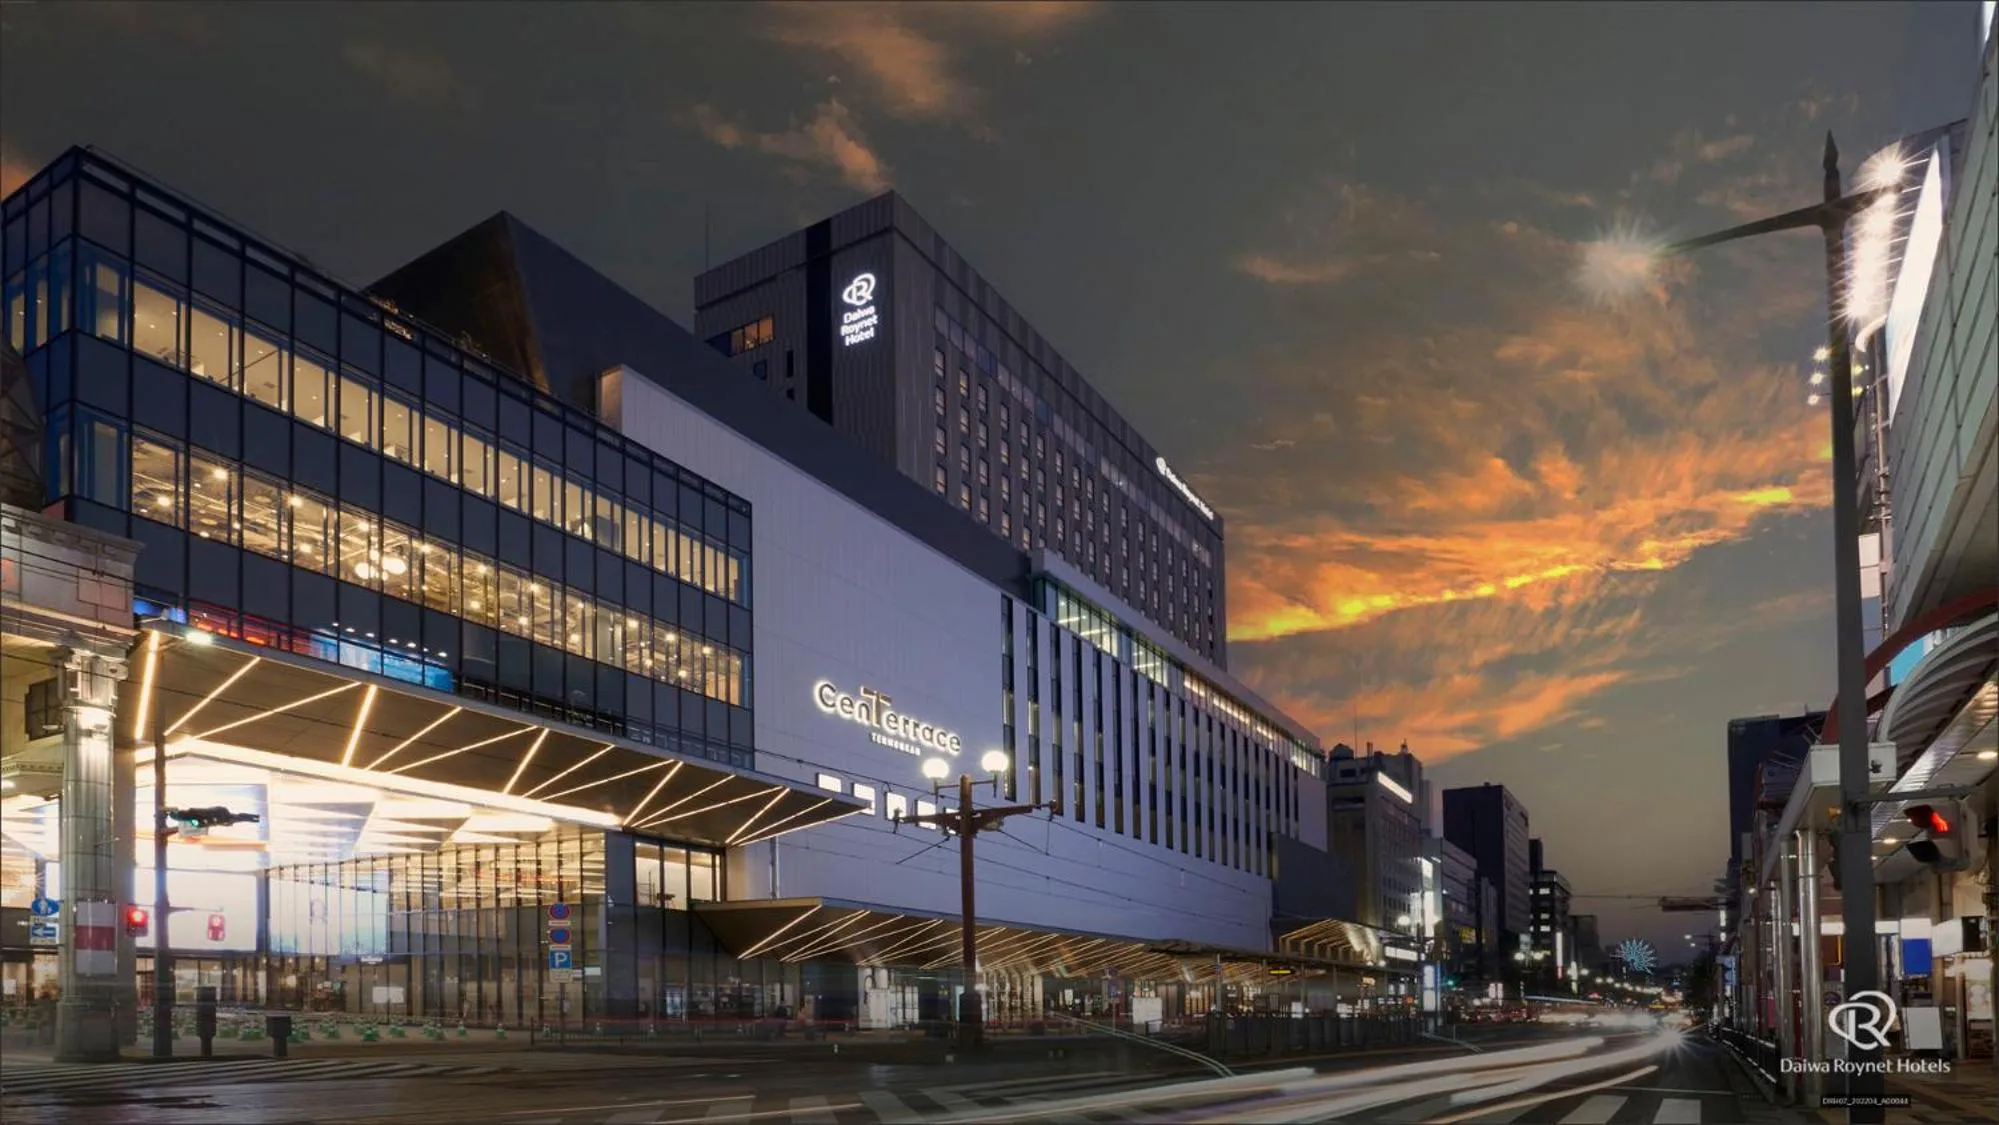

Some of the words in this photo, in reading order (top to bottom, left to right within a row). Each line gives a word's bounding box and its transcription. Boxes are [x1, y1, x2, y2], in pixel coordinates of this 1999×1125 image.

[843, 305, 875, 324] Daiwa
[841, 314, 878, 336] Roynet
[845, 327, 875, 346] Hotel
[815, 683, 961, 756] CenTerrace
